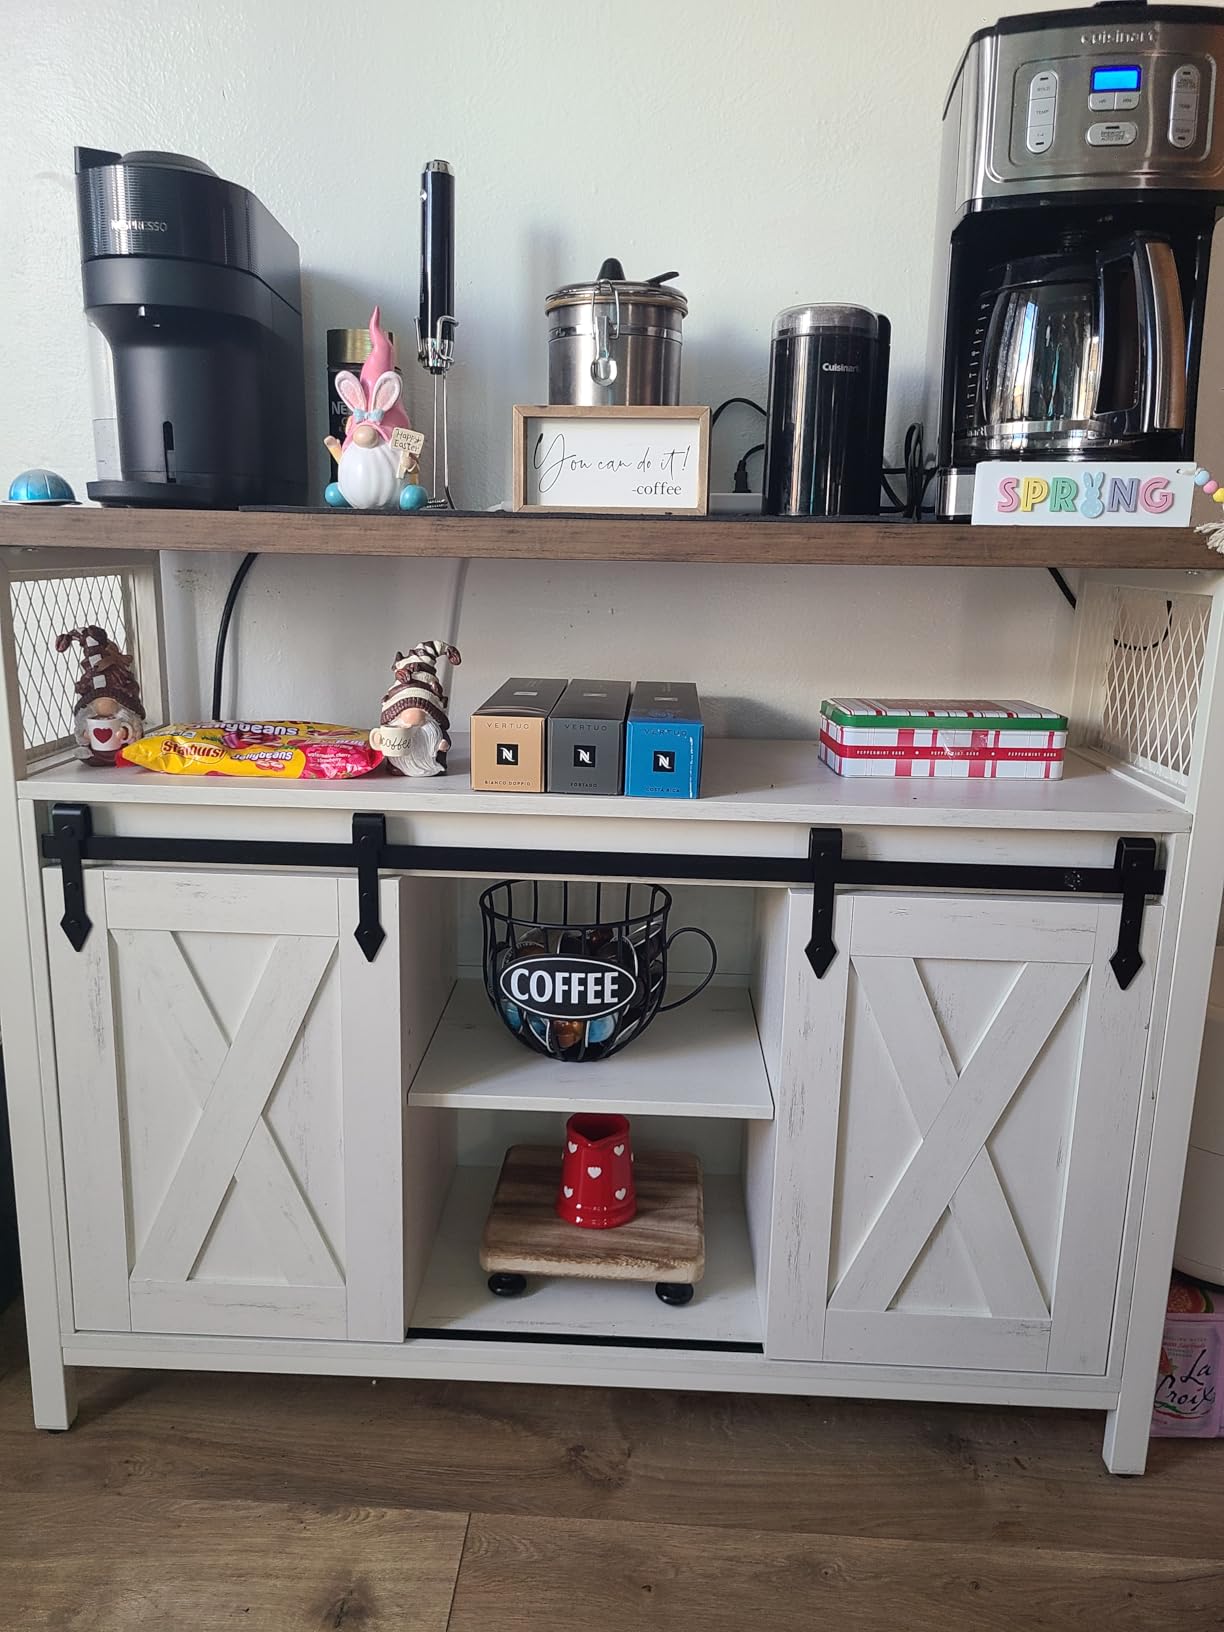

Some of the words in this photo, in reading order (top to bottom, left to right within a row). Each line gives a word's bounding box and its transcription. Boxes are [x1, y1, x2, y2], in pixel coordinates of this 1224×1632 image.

[822, 362, 860, 372] Cuisinart
[395, 428, 422, 444] Happy
[394, 440, 420, 452] Easter
[533, 432, 592, 494] You
[597, 460, 632, 471] can
[636, 447, 652, 473] do
[631, 481, 682, 496] -coffee
[644, 728, 688, 737] VERTUO
[510, 968, 619, 1005] COFFEE
[1180, 1349, 1211, 1386] La
[1154, 1374, 1215, 1411] Croix
